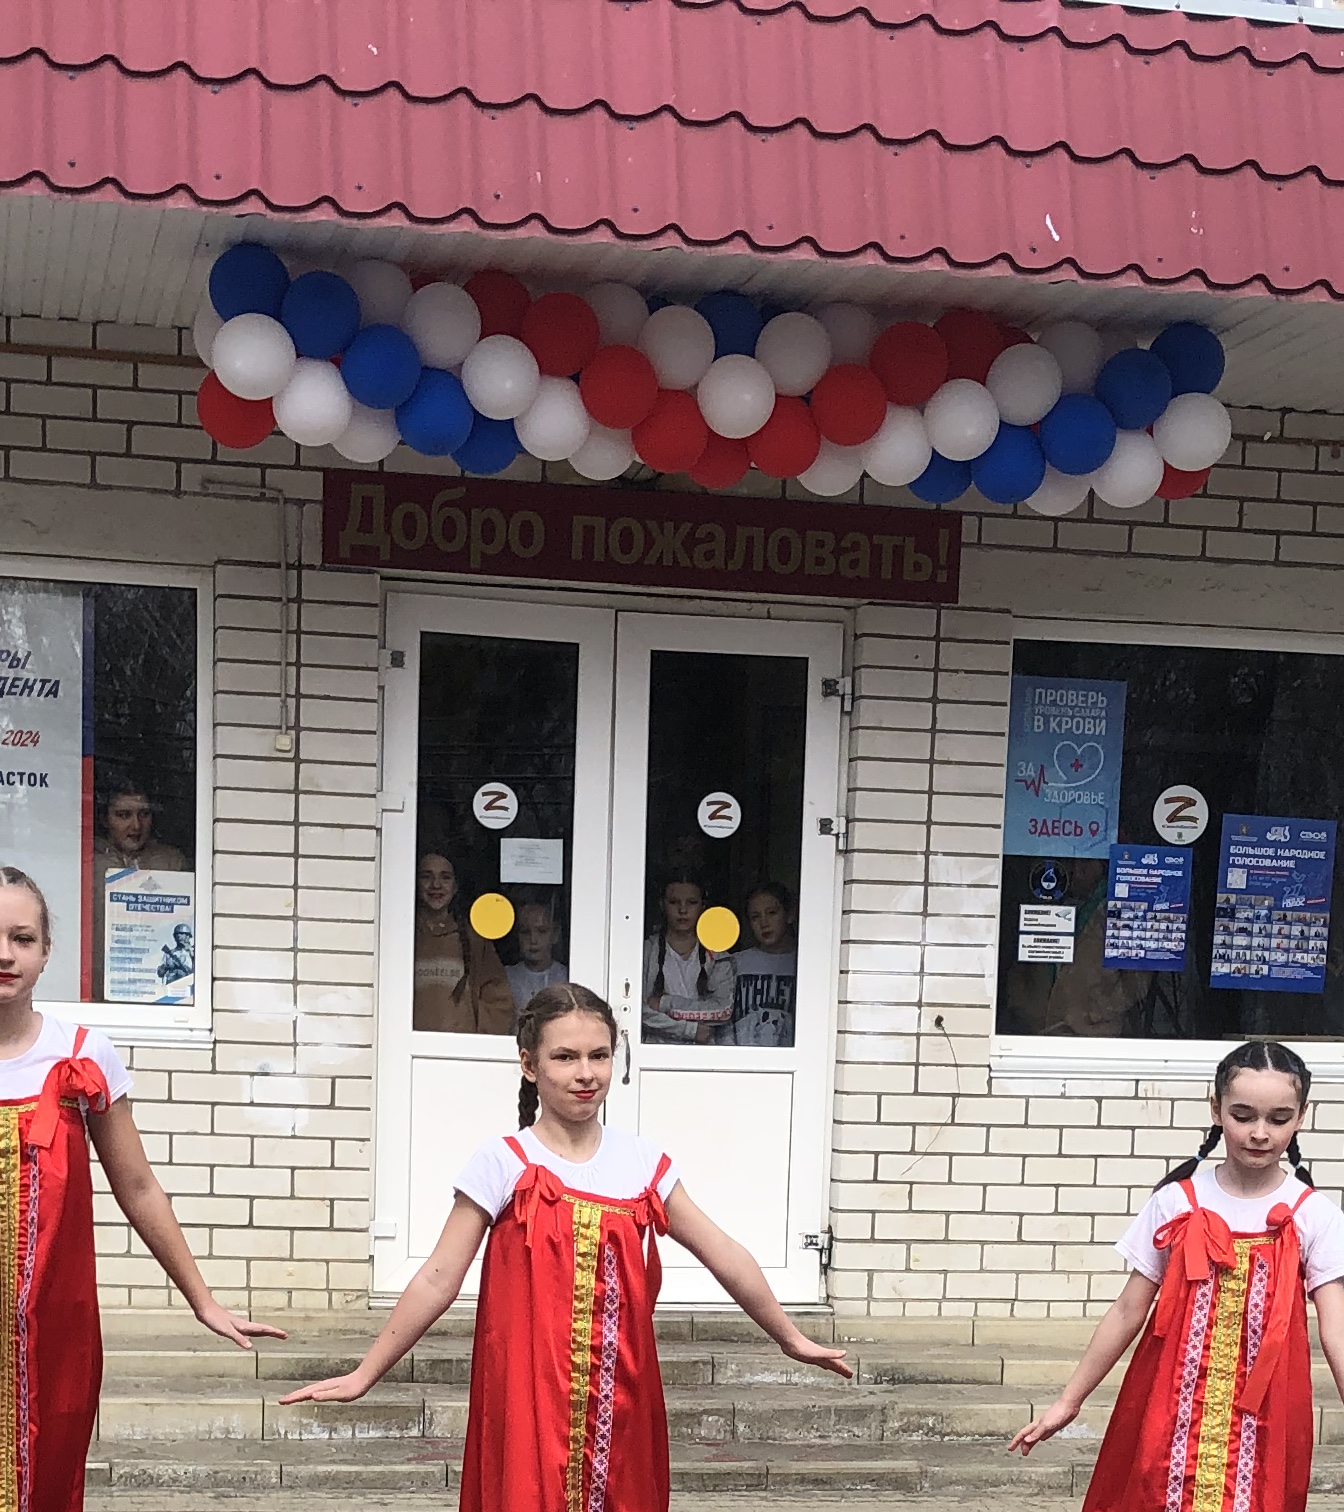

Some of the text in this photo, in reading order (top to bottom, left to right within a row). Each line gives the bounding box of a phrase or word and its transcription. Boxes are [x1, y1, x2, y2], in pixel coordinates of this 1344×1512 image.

[339, 482, 950, 583] Добро пожаловать!
[1035, 688, 1108, 708] ПРОВЕРЬ
[1033, 715, 1107, 736] В КРОВИ
[1, 729, 41, 748] 2024
[1017, 761, 1036, 777] ЗА
[1043, 788, 1105, 805] ЗДОРОВЬЕ
[1028, 818, 1084, 837] ЗДЕСЬ
[1230, 845, 1276, 856] БОЛЬШОЕ
